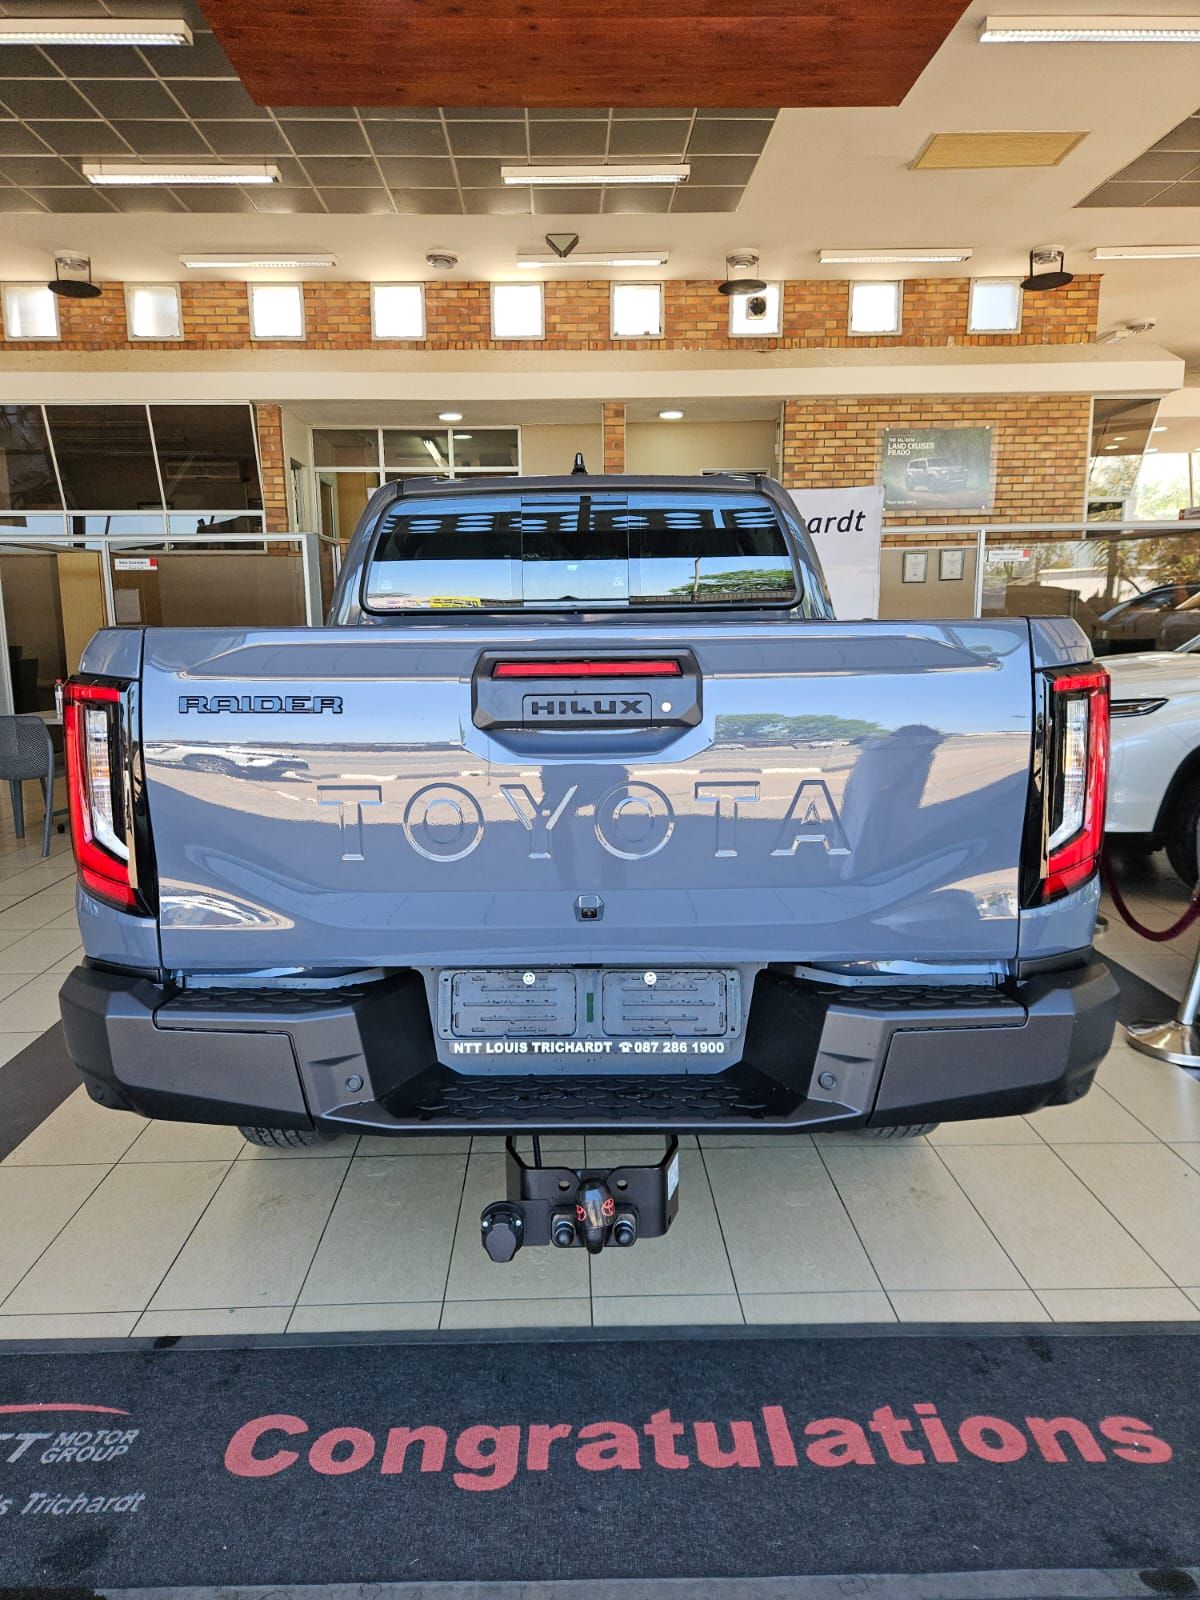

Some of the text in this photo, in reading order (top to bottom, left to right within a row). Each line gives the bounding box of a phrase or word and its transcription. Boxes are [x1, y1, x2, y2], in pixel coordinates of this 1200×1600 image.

[887, 442, 935, 450] LAND CRUISER
[807, 509, 866, 534] ardt
[178, 695, 344, 714] RAIDER
[531, 700, 643, 715] HILUX
[316, 779, 853, 862] TOYOTA
[453, 1041, 725, 1054] NTT LOUIS TRICHARDT 087 286 1900
[53, 1430, 140, 1447] MOTOR
[225, 1404, 1173, 1491] Congratulations
[40, 1446, 129, 1464] GROUP
[20, 1492, 146, 1515] Trichardt
